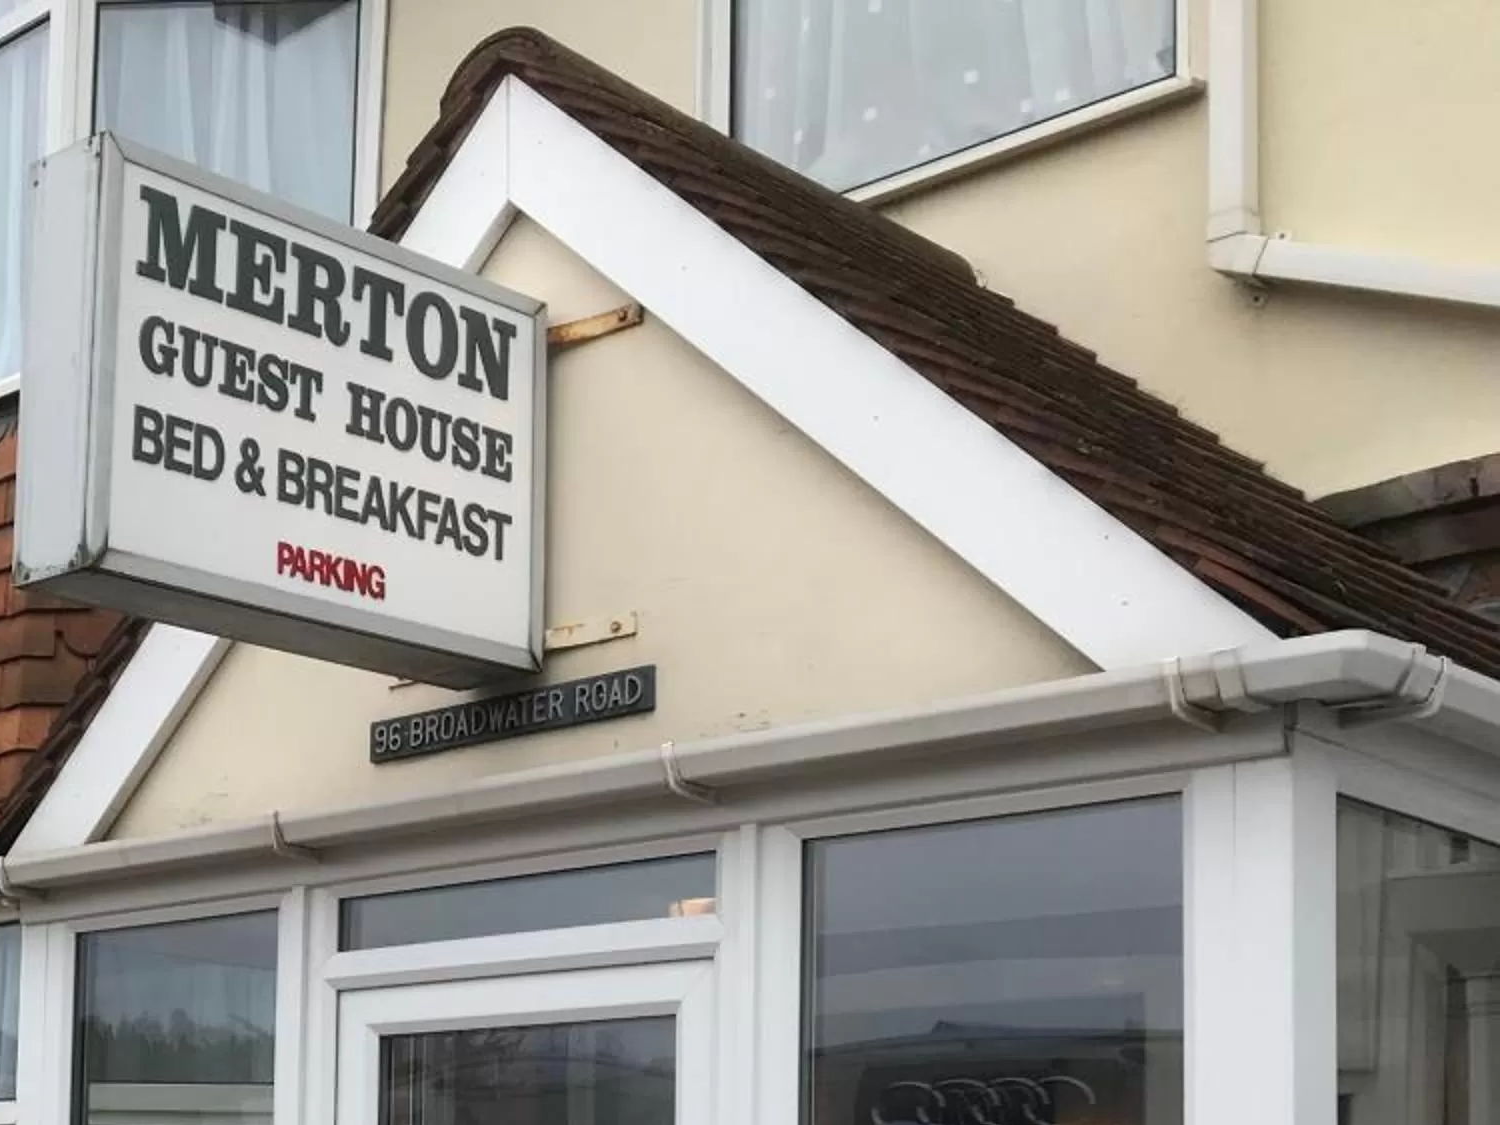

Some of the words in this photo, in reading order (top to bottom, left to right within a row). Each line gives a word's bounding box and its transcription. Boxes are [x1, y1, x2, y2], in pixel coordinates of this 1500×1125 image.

[136, 184, 516, 400] MERTON
[139, 315, 323, 422] GUEST
[346, 382, 513, 482] HOUSE
[132, 404, 225, 481] BED
[235, 437, 266, 497] &
[277, 449, 513, 561] BREAKFAST
[277, 541, 386, 600] PARKING
[375, 722, 401, 753] 96
[409, 689, 565, 747] BROADWATER
[575, 674, 642, 715] ROAD
